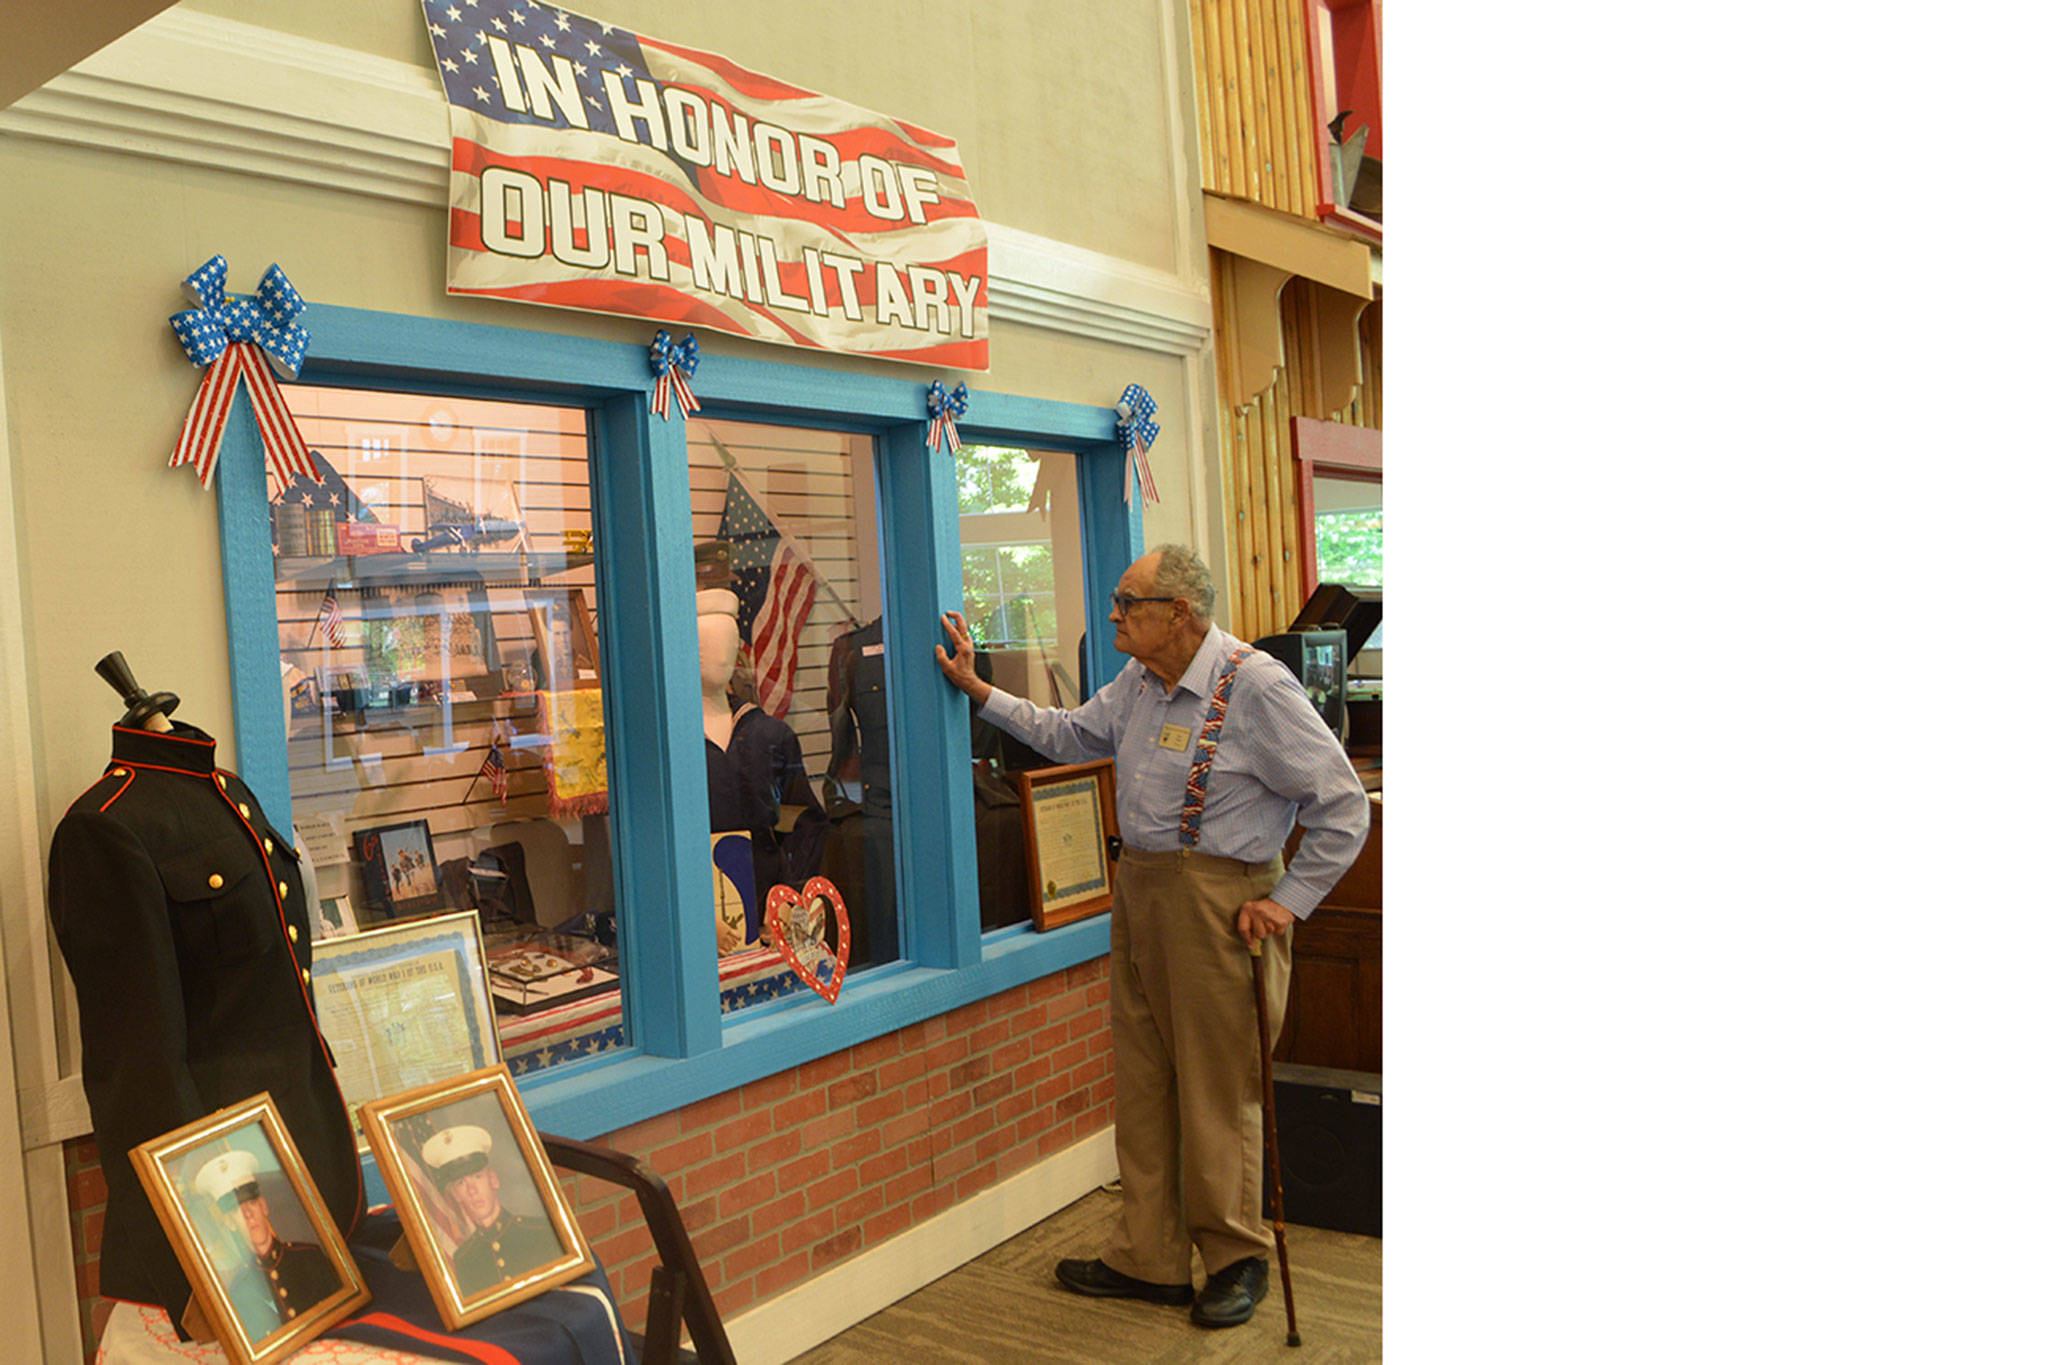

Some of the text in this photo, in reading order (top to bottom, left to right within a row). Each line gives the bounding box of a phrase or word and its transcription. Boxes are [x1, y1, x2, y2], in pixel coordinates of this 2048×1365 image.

[486, 34, 941, 225] IN HONOR OF
[479, 164, 982, 339] OUR MILITARY
